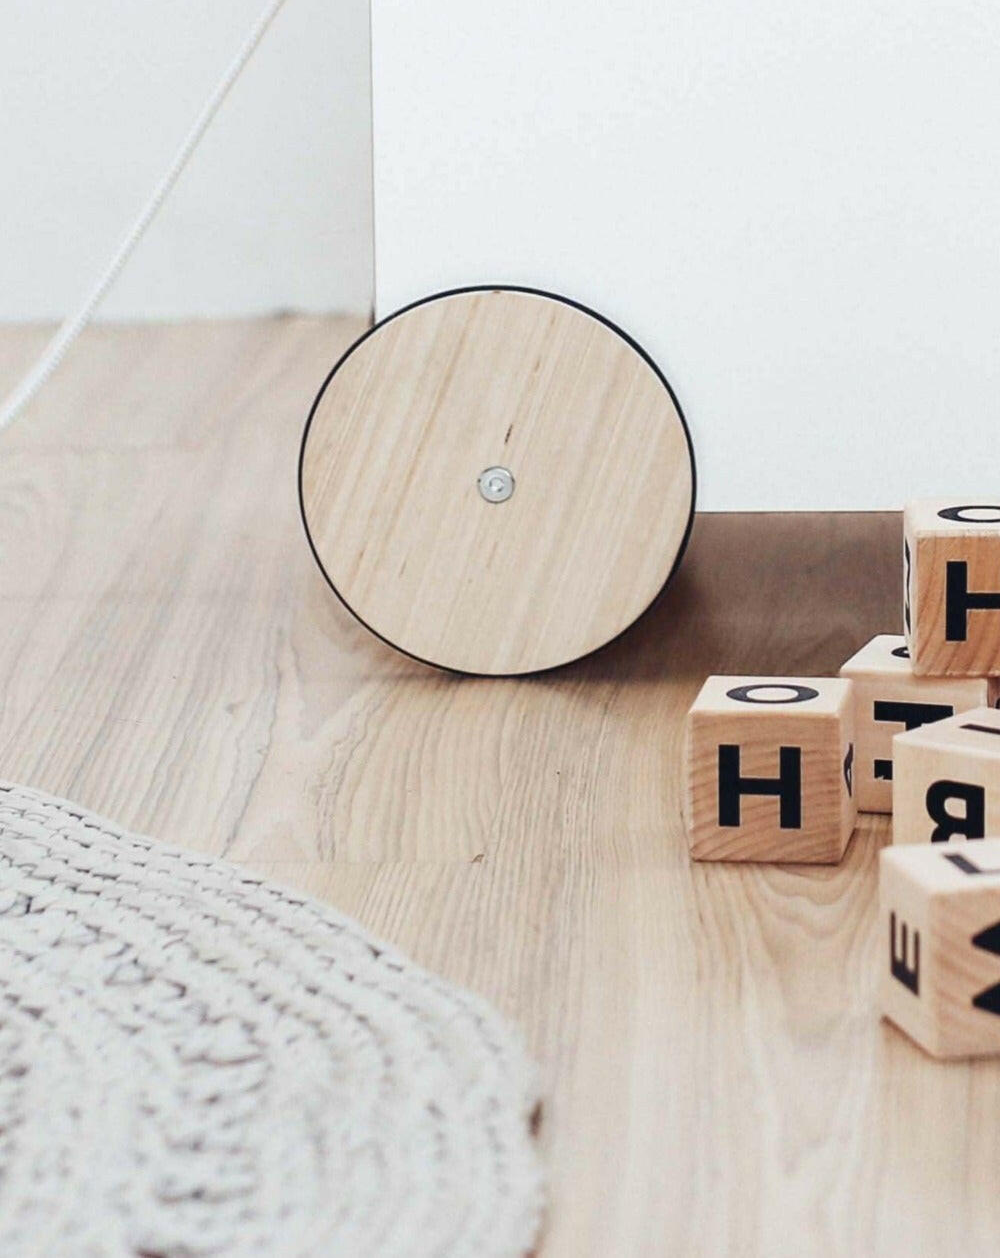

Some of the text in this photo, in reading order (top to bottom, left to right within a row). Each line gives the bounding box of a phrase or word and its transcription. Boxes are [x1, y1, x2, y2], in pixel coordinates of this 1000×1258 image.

[726, 684, 819, 704] O
[718, 744, 802, 830] H
[889, 911, 921, 997] E
